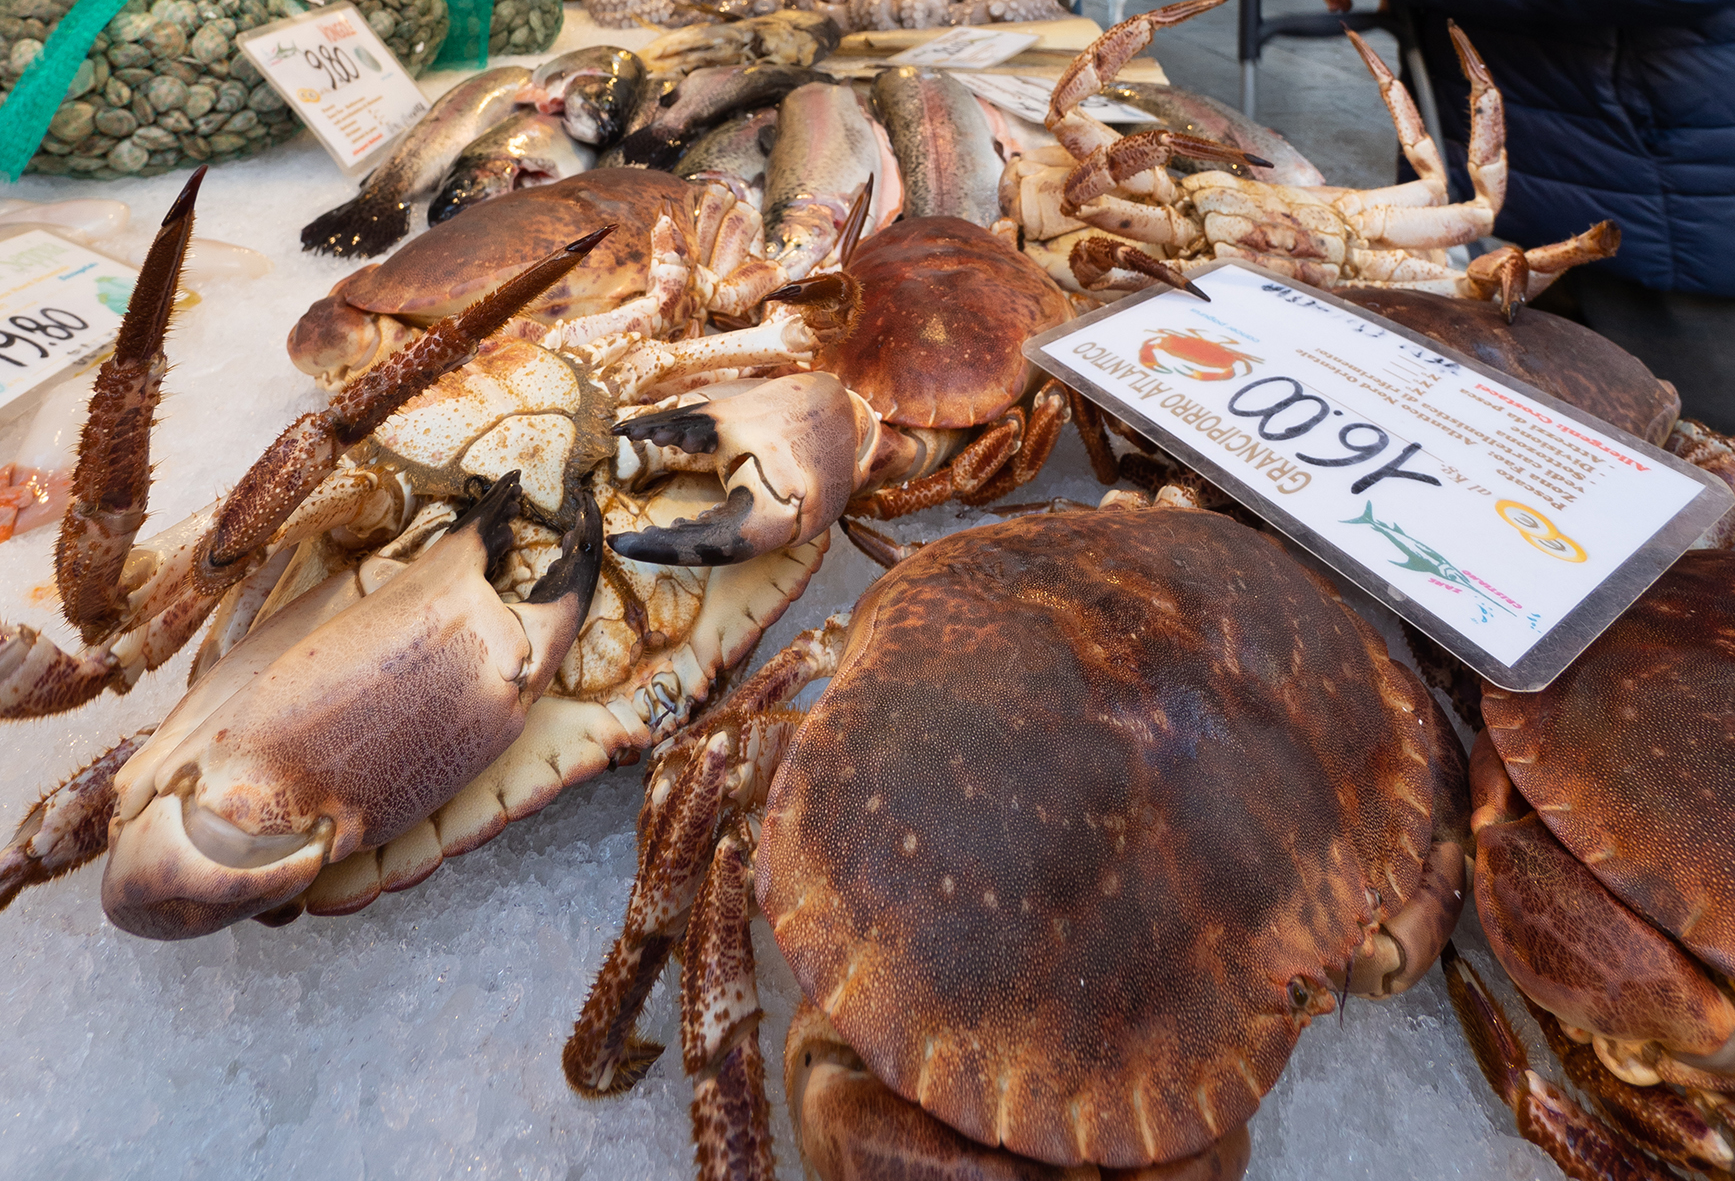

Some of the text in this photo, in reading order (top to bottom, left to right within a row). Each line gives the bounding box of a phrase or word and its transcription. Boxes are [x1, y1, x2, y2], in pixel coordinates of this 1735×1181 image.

[304, 45, 360, 90] 9.80
[1072, 341, 1313, 495] GRANCIPORRO ATLANTICO
[1314, 348, 1585, 494] vedi cartellonistica di riferimento:
[1459, 388, 1506, 412] pesca
[1507, 412, 1527, 424] da
[1228, 376, 1442, 495] 16.00
[1295, 349, 1578, 503] Zona Fao: Atlantico Nord Orientale
[1475, 383, 1652, 472] Allergeni: Crostacei
[1529, 424, 1606, 464] Attrezzi
[1496, 429, 1587, 480] Sottozona
[1510, 426, 1597, 473] Divisione
[1467, 484, 1493, 496] al
[1496, 469, 1568, 511] Pescato
[1462, 570, 1523, 609] CRISTIANO
